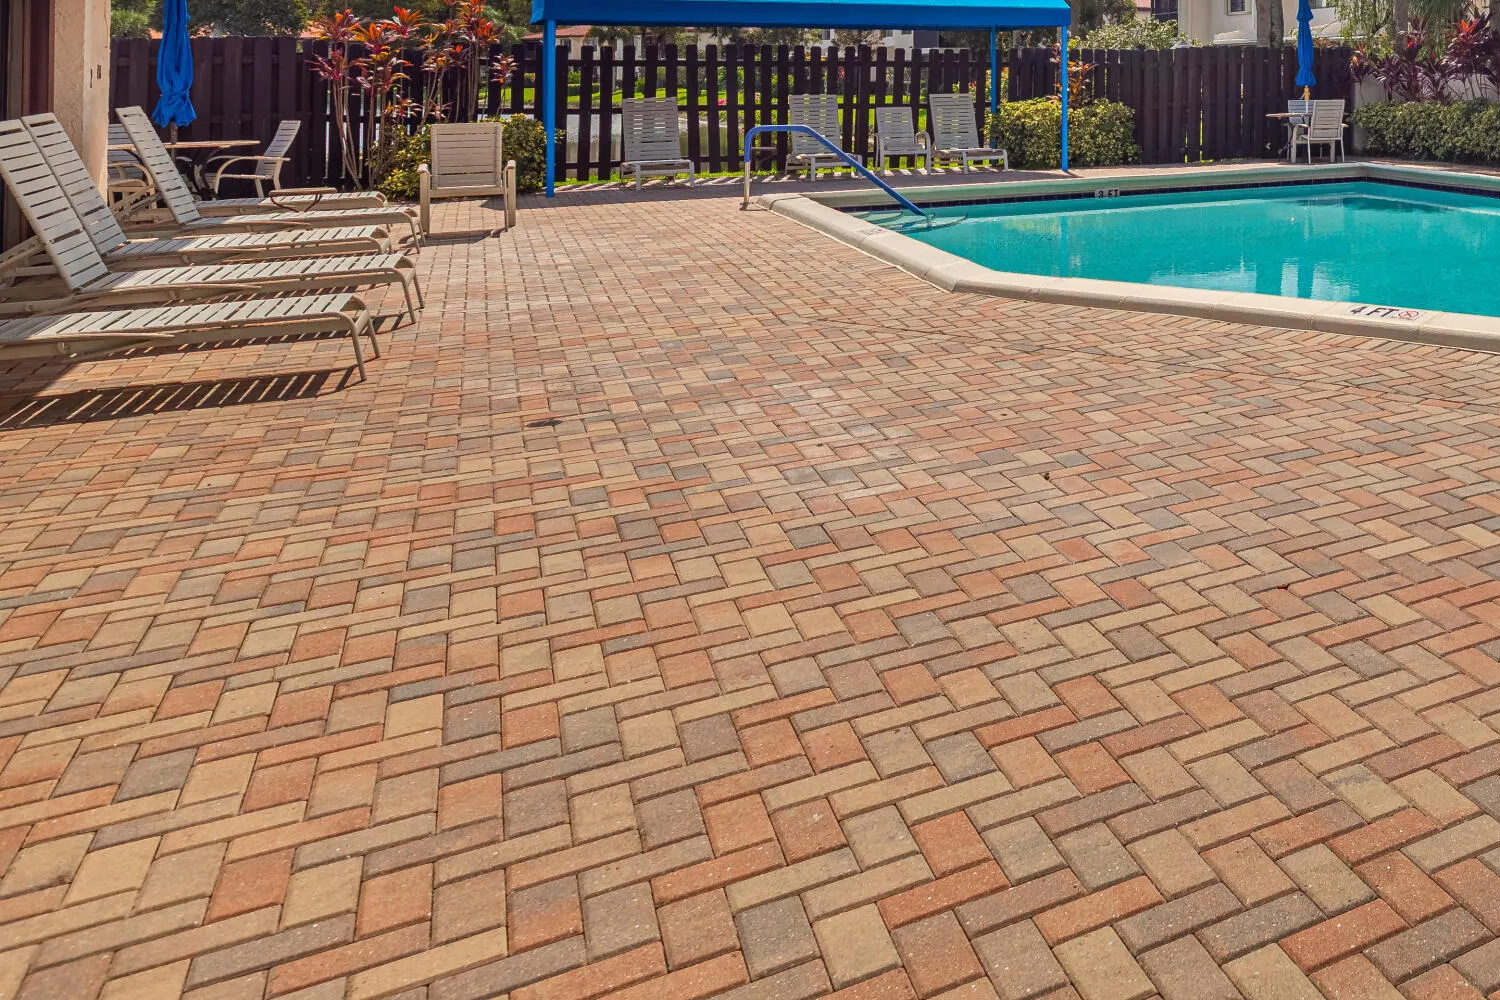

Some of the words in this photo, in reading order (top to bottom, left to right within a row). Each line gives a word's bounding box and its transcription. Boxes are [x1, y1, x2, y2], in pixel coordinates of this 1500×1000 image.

[1098, 190, 1104, 198] 3
[1108, 189, 1119, 197] FT
[1350, 306, 1368, 314] 4
[1366, 307, 1399, 317] FT
